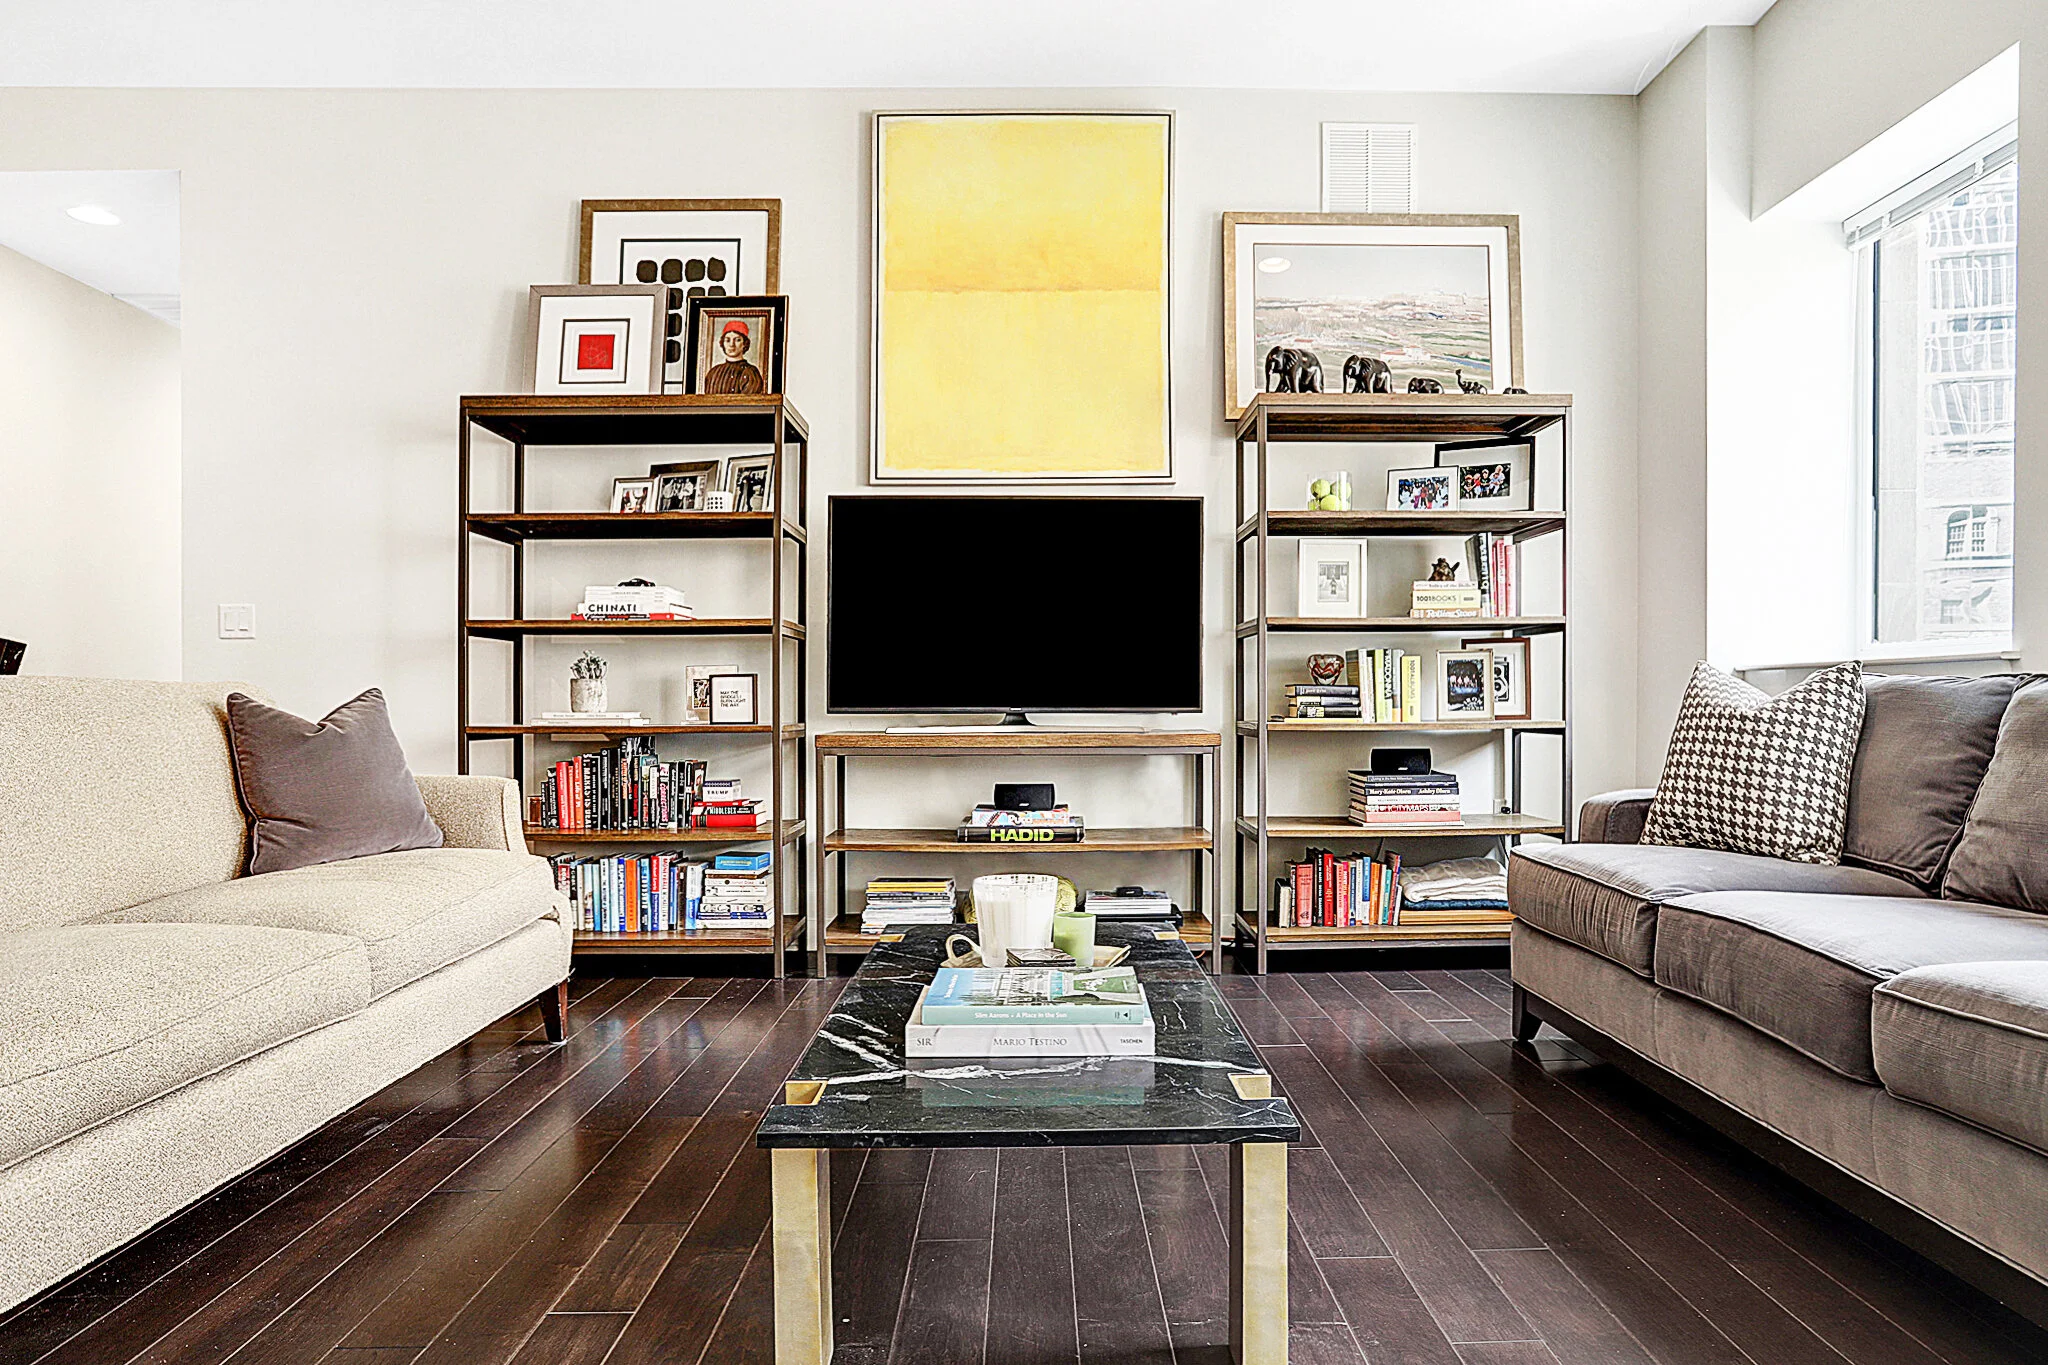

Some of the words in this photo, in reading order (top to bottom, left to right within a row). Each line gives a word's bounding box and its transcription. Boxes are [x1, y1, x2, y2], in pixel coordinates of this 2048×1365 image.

[588, 604, 637, 612] CHINATI
[990, 828, 1054, 842] HADID
[917, 1038, 932, 1046] SIR
